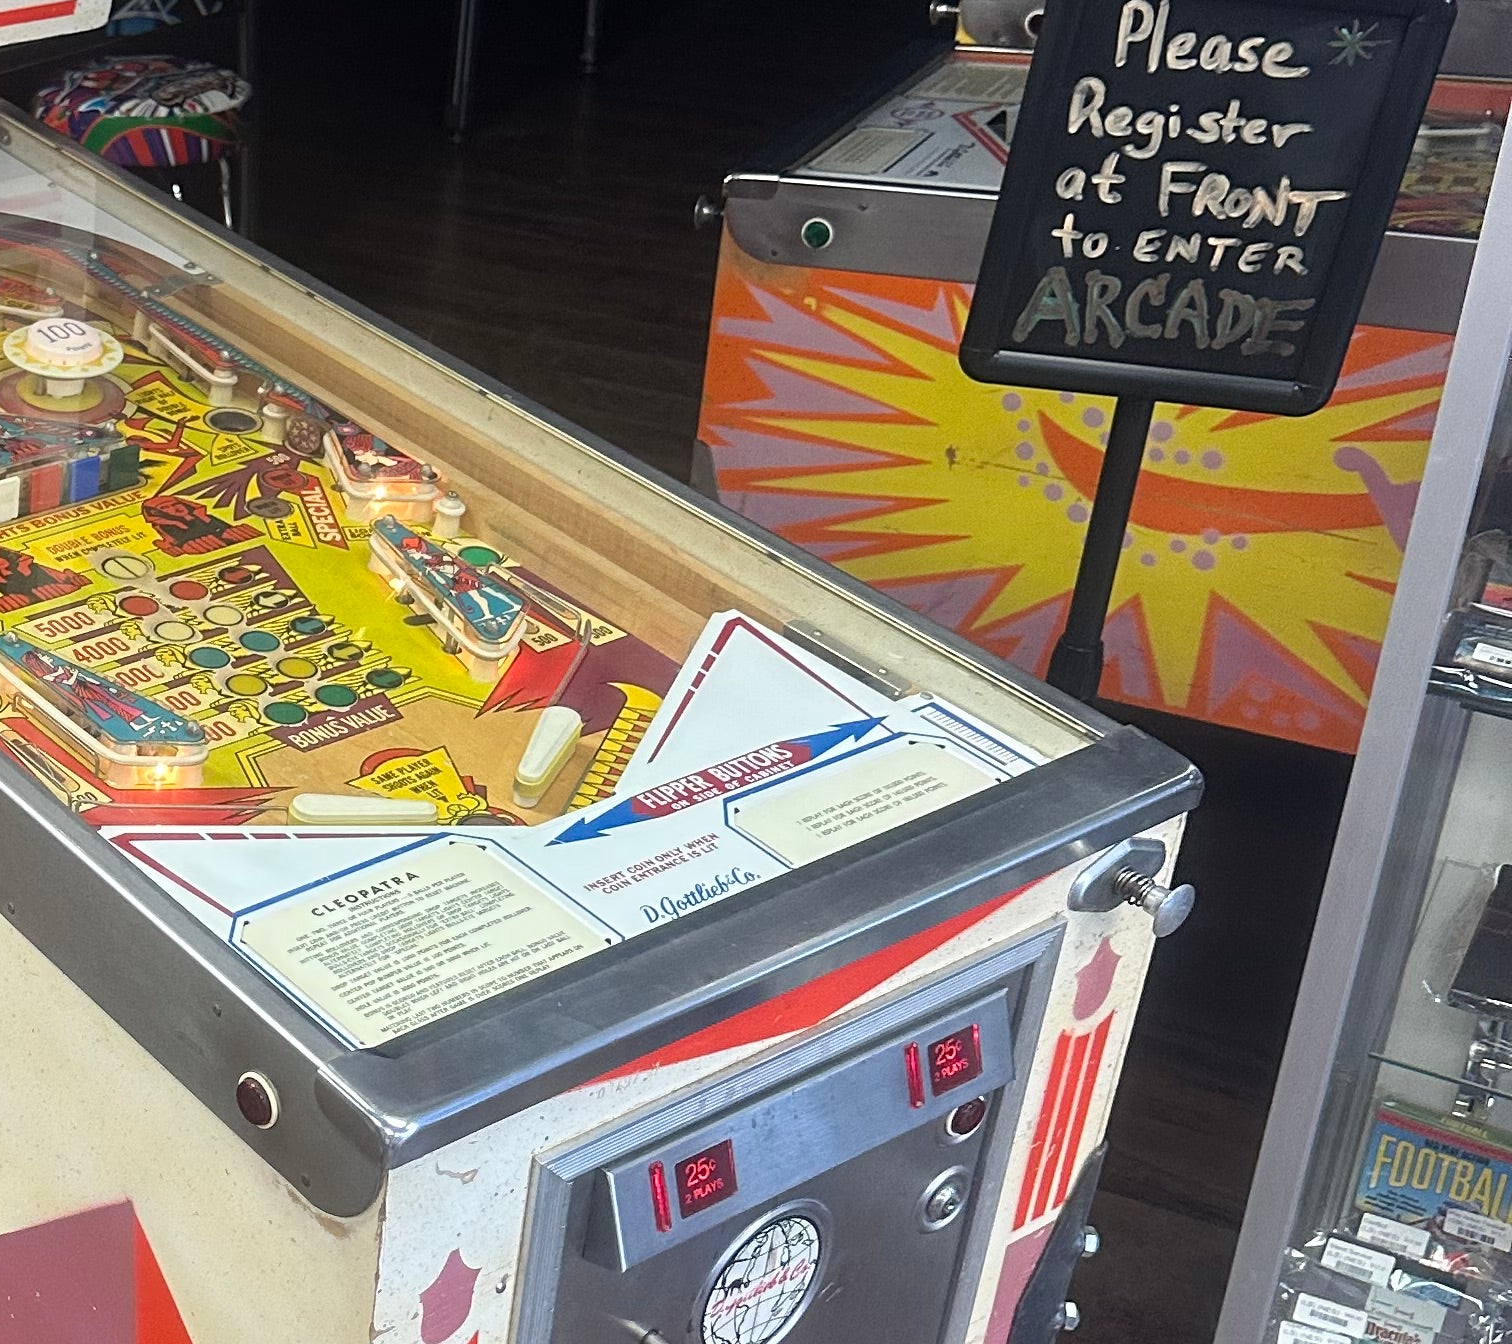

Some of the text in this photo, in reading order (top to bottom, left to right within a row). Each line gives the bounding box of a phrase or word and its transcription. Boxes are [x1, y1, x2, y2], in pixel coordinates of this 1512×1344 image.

[1068, 76, 1315, 159] Register
[1055, 152, 1351, 237] at FRONT
[1051, 213, 1308, 276] to ENTER
[37, 322, 87, 344] 100
[1012, 266, 1316, 356] ARCADE
[25, 509, 82, 534] BONUS
[85, 489, 148, 518] VALUE
[300, 485, 342, 542] SPECIAL
[46, 524, 131, 555] DOUBLE BONUS
[54, 549, 81, 564] WHEN
[34, 612, 94, 639] 5000
[531, 632, 560, 648] 500
[74, 637, 131, 664] 4000
[288, 704, 397, 749] BONUS VALUE
[370, 758, 433, 786] SAME PLAYER
[380, 765, 442, 794] SHOOTS AGAIN
[408, 778, 440, 798] WHEN
[637, 742, 796, 811] FLIPPER BUTTONS
[670, 759, 796, 813] ON SIDE OF CABINET
[583, 832, 720, 893] INSERT COIN ONLY WHEN
[602, 842, 720, 896] COIN ENTRANCE IS LIT
[308, 869, 421, 918] CLEOPATRA
[346, 888, 403, 913] INSTRUCTIONS
[941, 1057, 969, 1079] PLAYS
[693, 1177, 725, 1200] PLAYS
[1369, 1134, 1511, 1222] FOOTBAL
